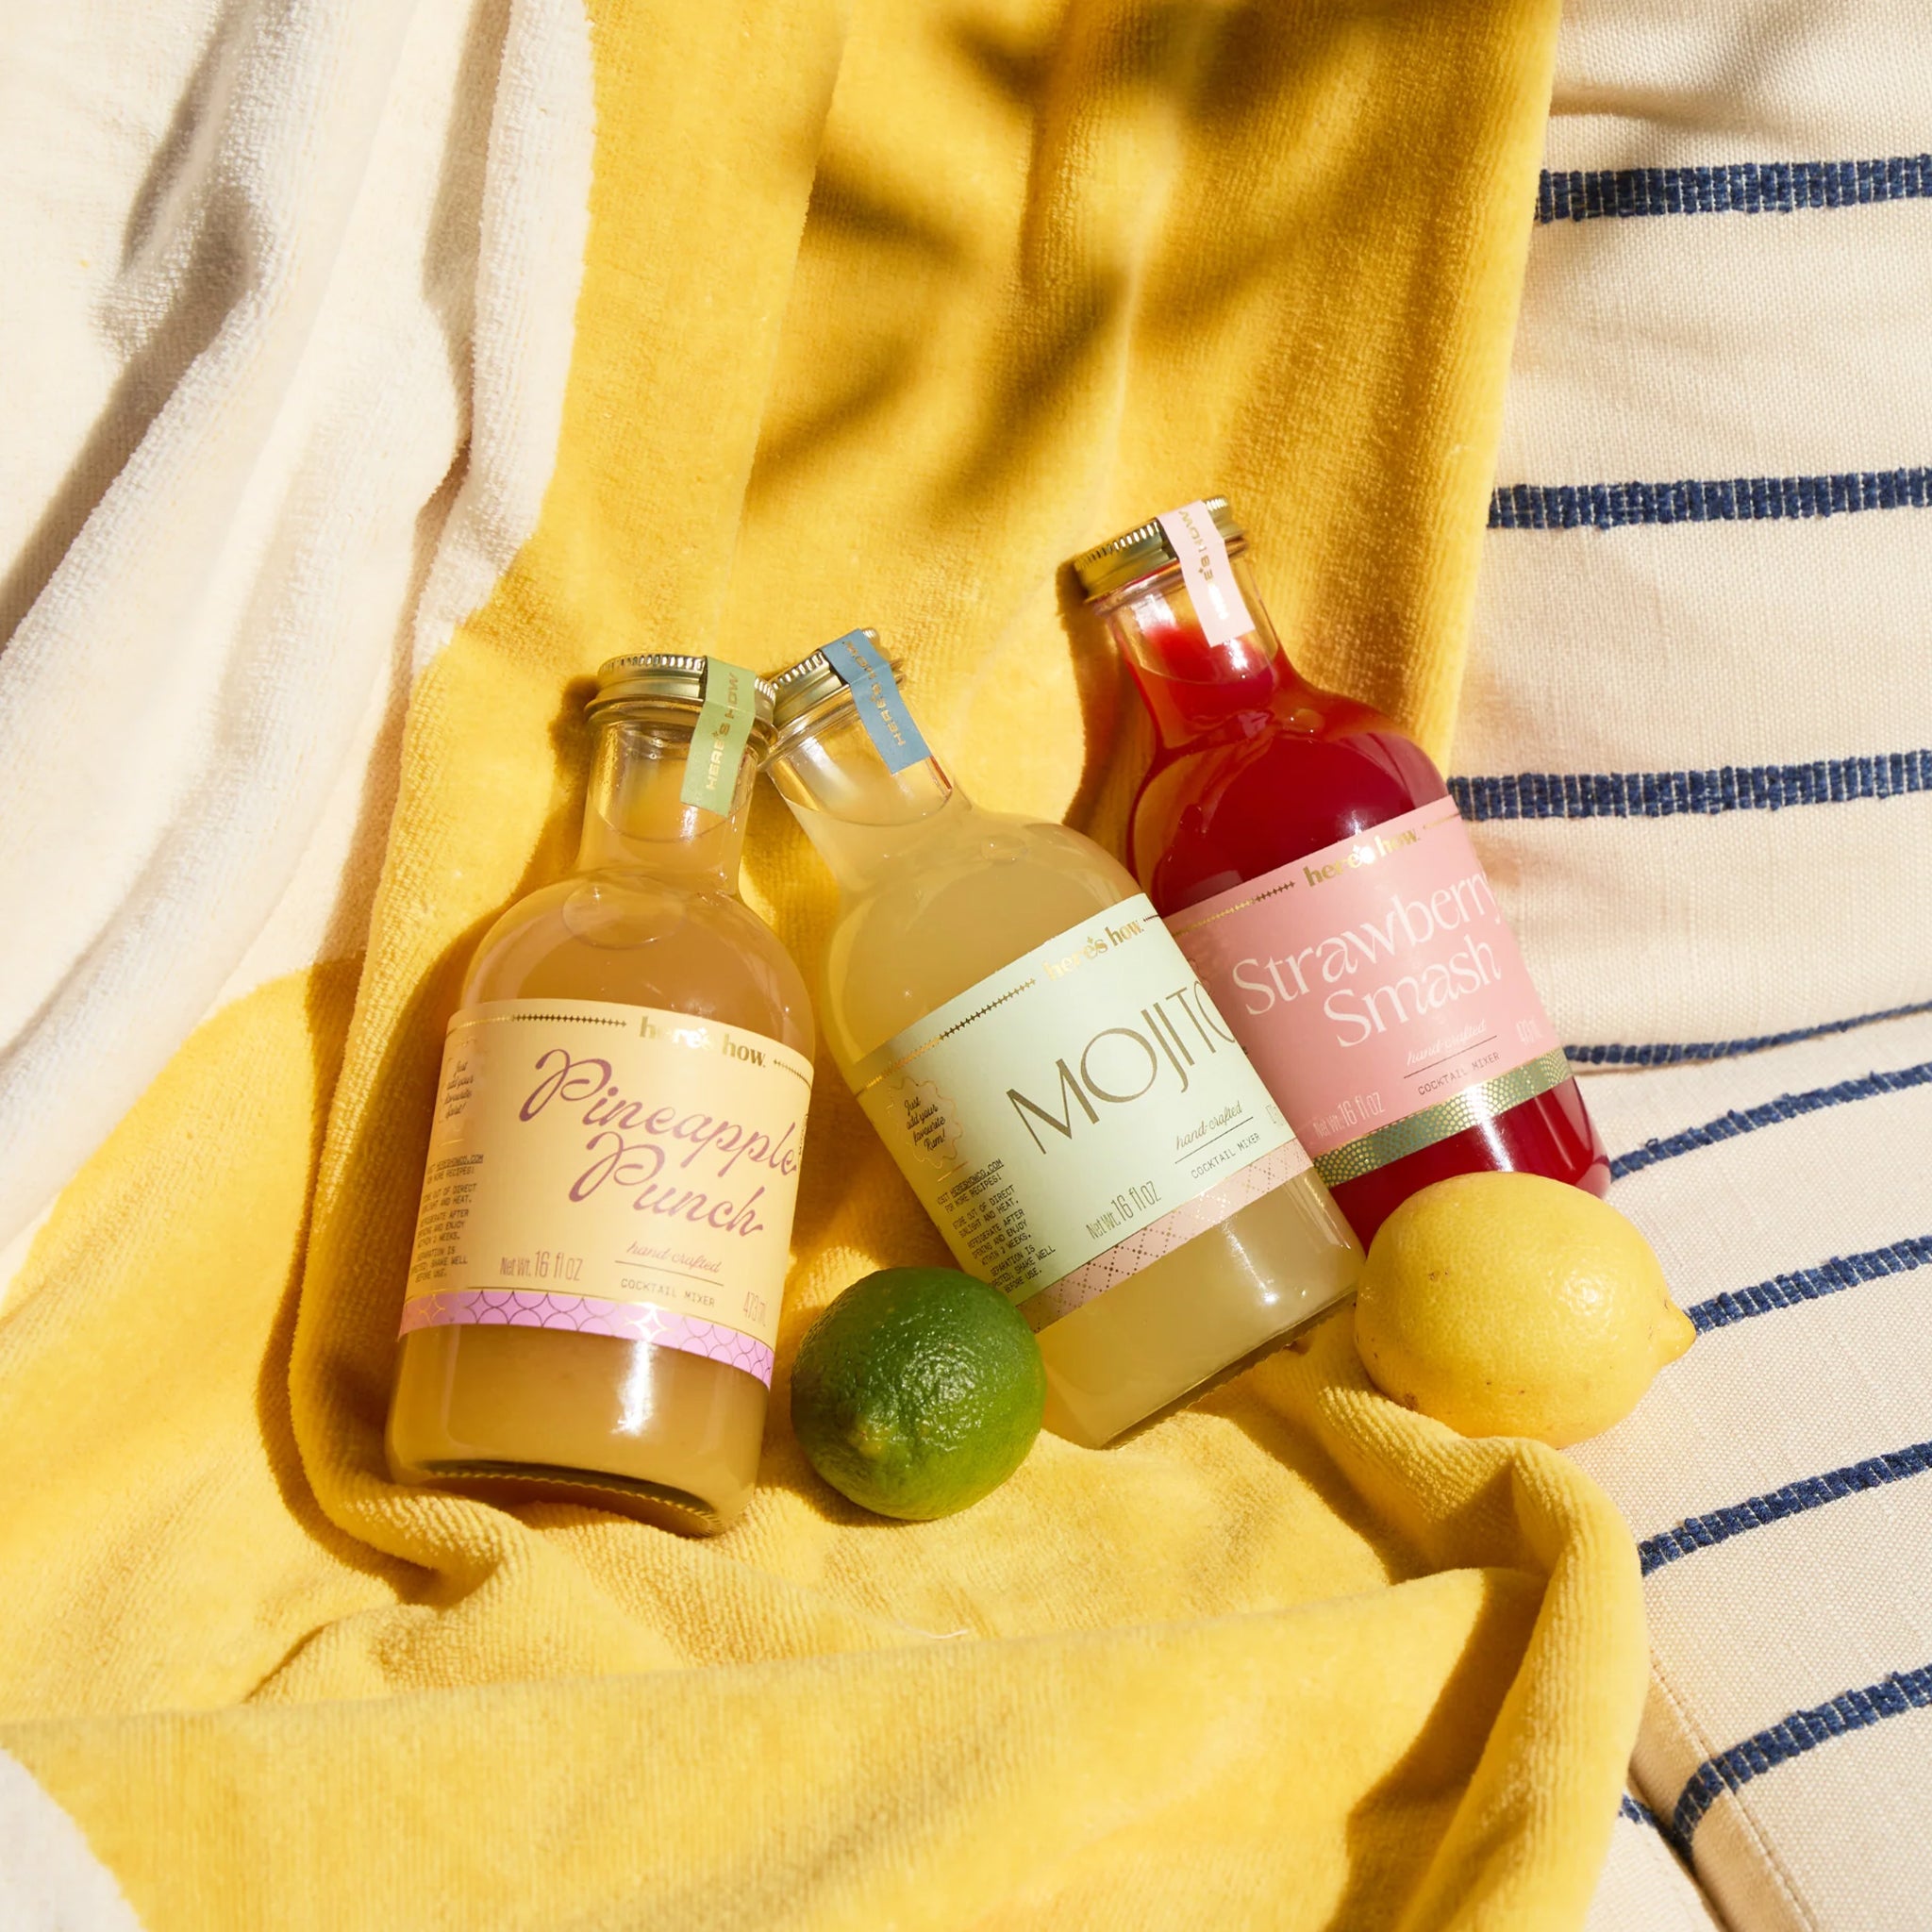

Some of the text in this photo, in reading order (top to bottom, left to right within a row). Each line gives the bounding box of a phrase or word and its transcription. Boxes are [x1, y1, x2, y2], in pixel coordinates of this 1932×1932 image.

[706, 673, 739, 791] HERE'S HOW
[1232, 870, 1501, 1015] Strawberry
[1041, 936, 1108, 981] here's
[1323, 934, 1501, 1048] Smash
[1418, 1052, 1501, 1095] COCKTAIL MIXER
[519, 1048, 797, 1177] Pineapple
[904, 1096, 922, 1117] Just
[919, 1104, 939, 1124] your
[1337, 1100, 1358, 1127] 16
[1365, 1091, 1386, 1116] oz
[1175, 1099, 1243, 1151] hand-crafted
[1191, 1132, 1261, 1179] COCKTAIL MIXER
[453, 1183, 477, 1194] DIRECT
[568, 1130, 764, 1237] Punch
[969, 1172, 1002, 1197] RECIPES!
[979, 1201, 987, 1212] OF
[989, 1184, 1015, 1207] DIRECT
[449, 1208, 469, 1219] AFTER
[983, 1210, 996, 1222] AND
[996, 1197, 1019, 1215] HEAT.
[1003, 1208, 1025, 1226] AFTER
[1086, 1219, 1108, 1240] Net
[1110, 1194, 1134, 1221] 16
[1128, 1187, 1147, 1211] fl
[1141, 1180, 1161, 1206] oz
[993, 1234, 1006, 1245] AND
[1006, 1219, 1027, 1237] ENJOY
[1006, 1232, 1031, 1249] WEEKS.
[451, 1256, 468, 1265] WELL
[1014, 1257, 1036, 1274] SHAKE
[1036, 1245, 1056, 1260] WELL
[1024, 1244, 1036, 1255] IS
[499, 1257, 517, 1276] Net
[534, 1250, 550, 1278] 16
[553, 1252, 565, 1278] fl
[565, 1257, 584, 1281] oz
[620, 1277, 716, 1308] COCKTAIL MIXER
